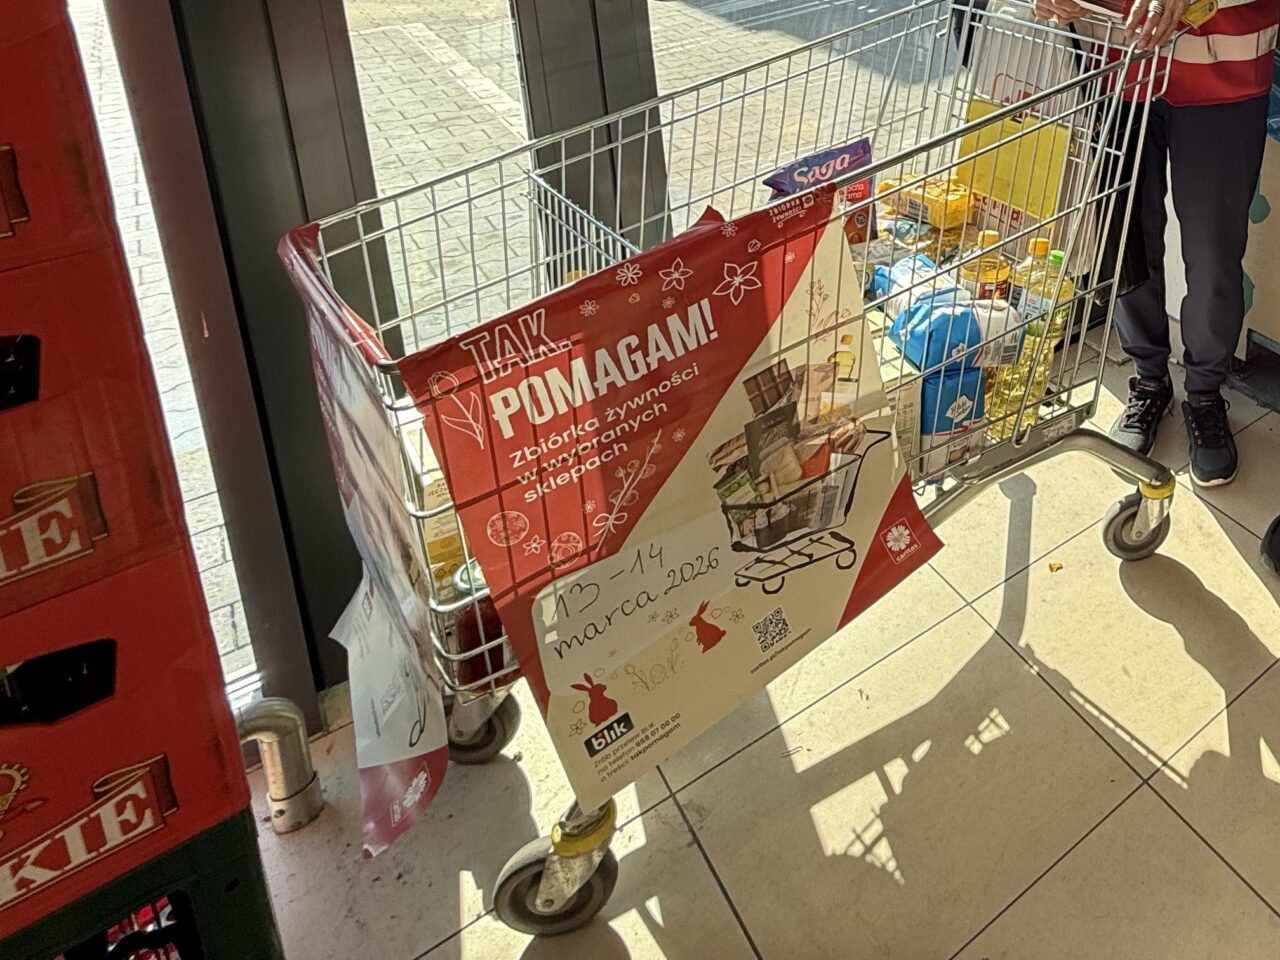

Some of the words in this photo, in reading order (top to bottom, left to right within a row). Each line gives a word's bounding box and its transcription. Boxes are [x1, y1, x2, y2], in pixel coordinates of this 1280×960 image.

[794, 153, 850, 187] Saga
[460, 309, 572, 385] TAK.
[489, 298, 719, 440] POMAGAM!
[508, 416, 601, 469] Zbiórka
[605, 362, 700, 424] żywności
[516, 468, 539, 485] w
[541, 400, 668, 472] wybranych
[523, 441, 629, 503] sklepach
[551, 582, 600, 621] 13
[630, 542, 664, 575] 14
[896, 542, 920, 563] caritas
[553, 590, 659, 660] marca
[663, 546, 721, 596] 2026
[591, 721, 629, 751] blik
[629, 722, 681, 761] takpomagam
[660, 720, 671, 730] 00
[670, 712, 681, 723] 00
